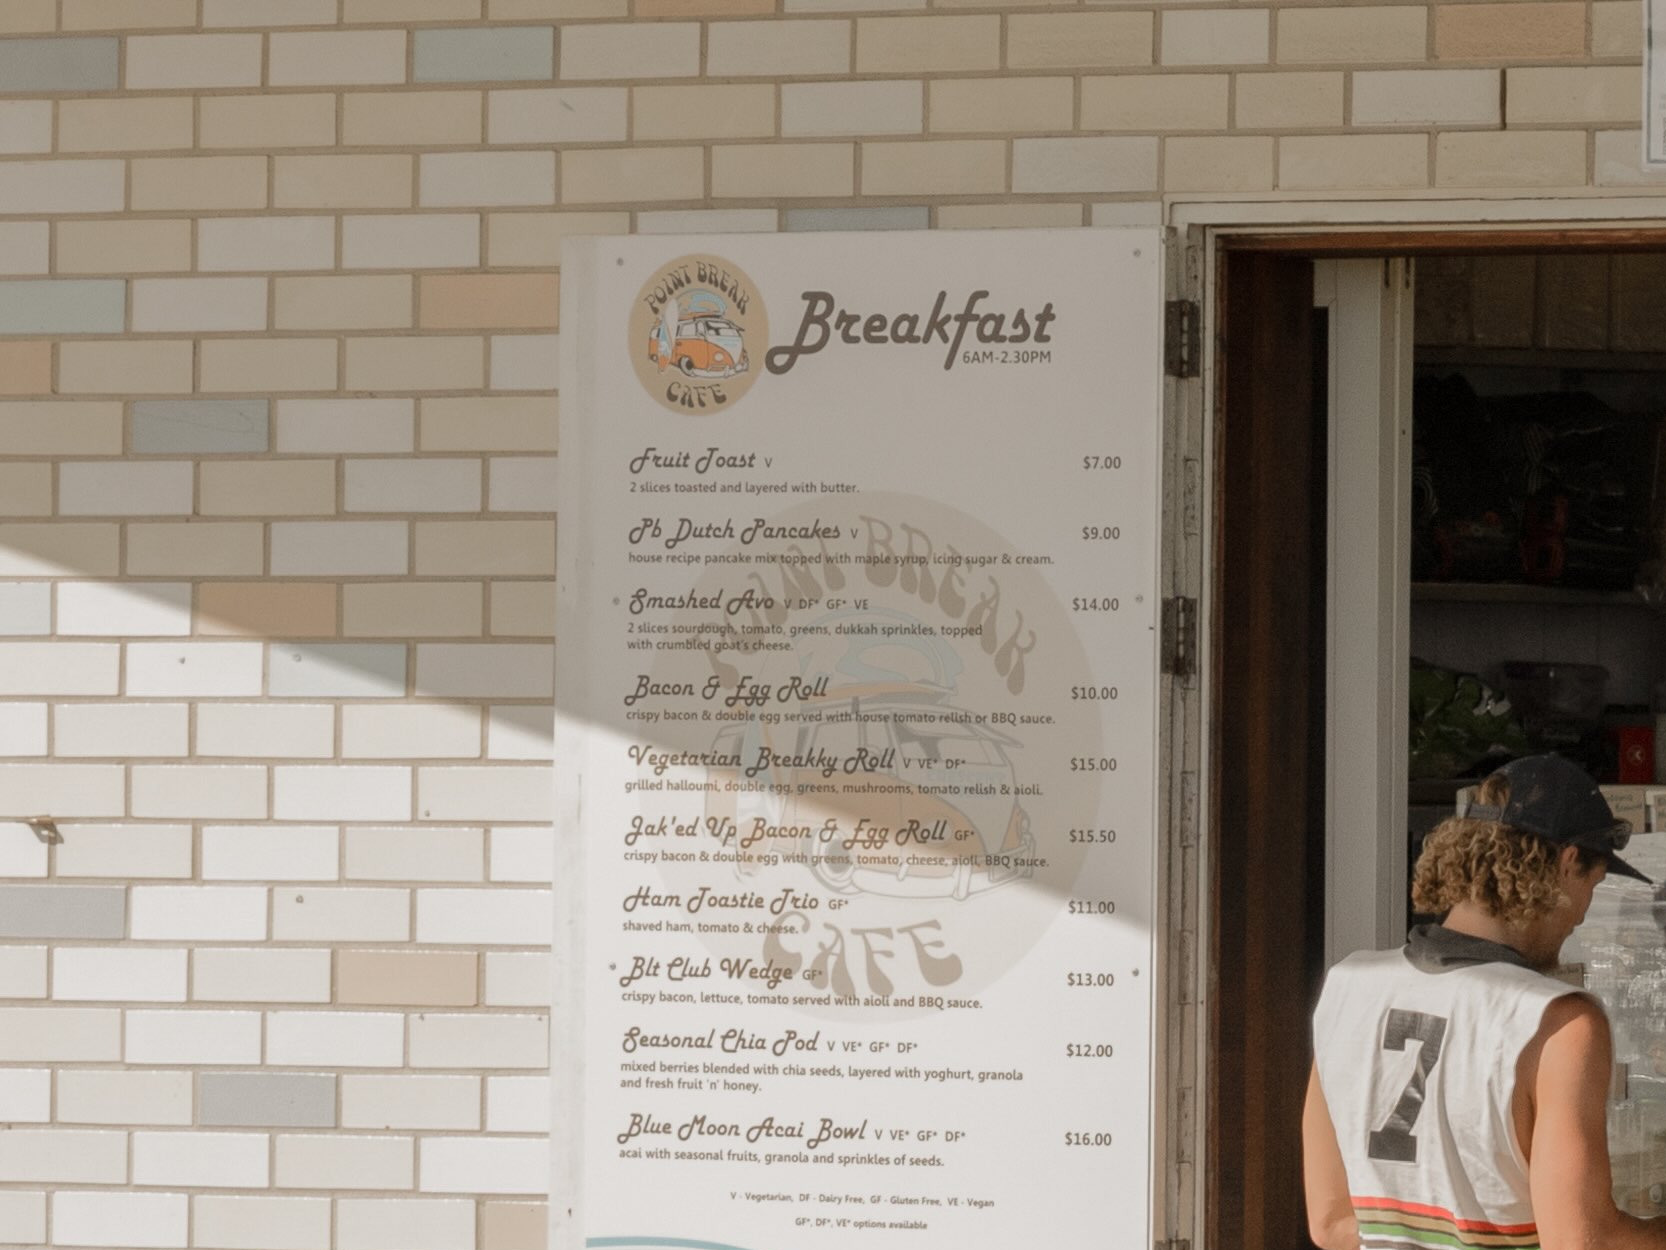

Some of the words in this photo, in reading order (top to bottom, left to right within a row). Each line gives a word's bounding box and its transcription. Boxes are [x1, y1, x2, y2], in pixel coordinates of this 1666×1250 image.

[643, 265, 692, 315] POINT
[696, 261, 751, 315] BREAK
[765, 290, 1056, 375] Breakfast
[962, 350, 1051, 364] 6AM-2.30PM
[666, 381, 727, 408] CAFE
[630, 448, 690, 474] Fruit
[695, 448, 755, 474] Toast
[764, 457, 773, 468] V
[1083, 455, 1122, 470] $7.00
[630, 481, 637, 493] 2
[640, 482, 671, 493] slices
[674, 481, 717, 493] toasted
[720, 482, 742, 493] and
[745, 482, 788, 496] layered
[791, 481, 817, 493] with
[820, 482, 860, 493] butter.
[629, 518, 661, 544] Pb
[665, 518, 734, 549] Dutch
[741, 519, 840, 545] Pancakes
[850, 528, 858, 539] V
[1082, 526, 1121, 540] $9.00
[629, 588, 723, 614] Smashed
[726, 589, 775, 615] Avo
[1072, 597, 1120, 612] $14.00
[624, 675, 694, 706] Bacon
[702, 675, 720, 700] &
[725, 676, 771, 707] Egg
[777, 676, 829, 703] Roll
[1071, 686, 1118, 700] $10.00
[628, 746, 741, 776] Vegetarian
[745, 747, 838, 778] Breakky
[844, 747, 895, 774] Roll
[1070, 757, 1117, 772] $15.00
[706, 817, 736, 846] Up
[740, 818, 812, 849] Bacon
[819, 819, 837, 842] &
[842, 819, 889, 850] Egg
[895, 820, 947, 846] Roll
[1069, 828, 1116, 844] $15.50
[623, 886, 681, 912] Ham
[687, 887, 764, 913] Toastie
[770, 889, 818, 915] Trio
[1068, 900, 1116, 915] $11.00
[620, 957, 660, 987] Blt
[667, 957, 711, 981] Club
[720, 958, 792, 989] Wedge
[1067, 972, 1115, 987] $13.00
[623, 1027, 715, 1053] Seasonal
[721, 1029, 766, 1053] Chia
[772, 1030, 820, 1056] Pod
[1066, 1043, 1114, 1058] $12.00
[1369, 1008, 1448, 1163] 7
[617, 1114, 671, 1144] Blue
[678, 1115, 740, 1141] Moon
[746, 1117, 804, 1143] Acai
[807, 1118, 867, 1149] Bowl
[1065, 1131, 1113, 1147] $16.00
[619, 1149, 642, 1159] acai
[645, 1148, 671, 1159] with
[674, 1149, 724, 1161] seasonal
[727, 1149, 761, 1164] fruits,
[764, 1151, 809, 1166] granola
[812, 1152, 834, 1164] and
[837, 1153, 891, 1167] sprinkles
[893, 1153, 907, 1166] of
[909, 1155, 945, 1167] seeds.
